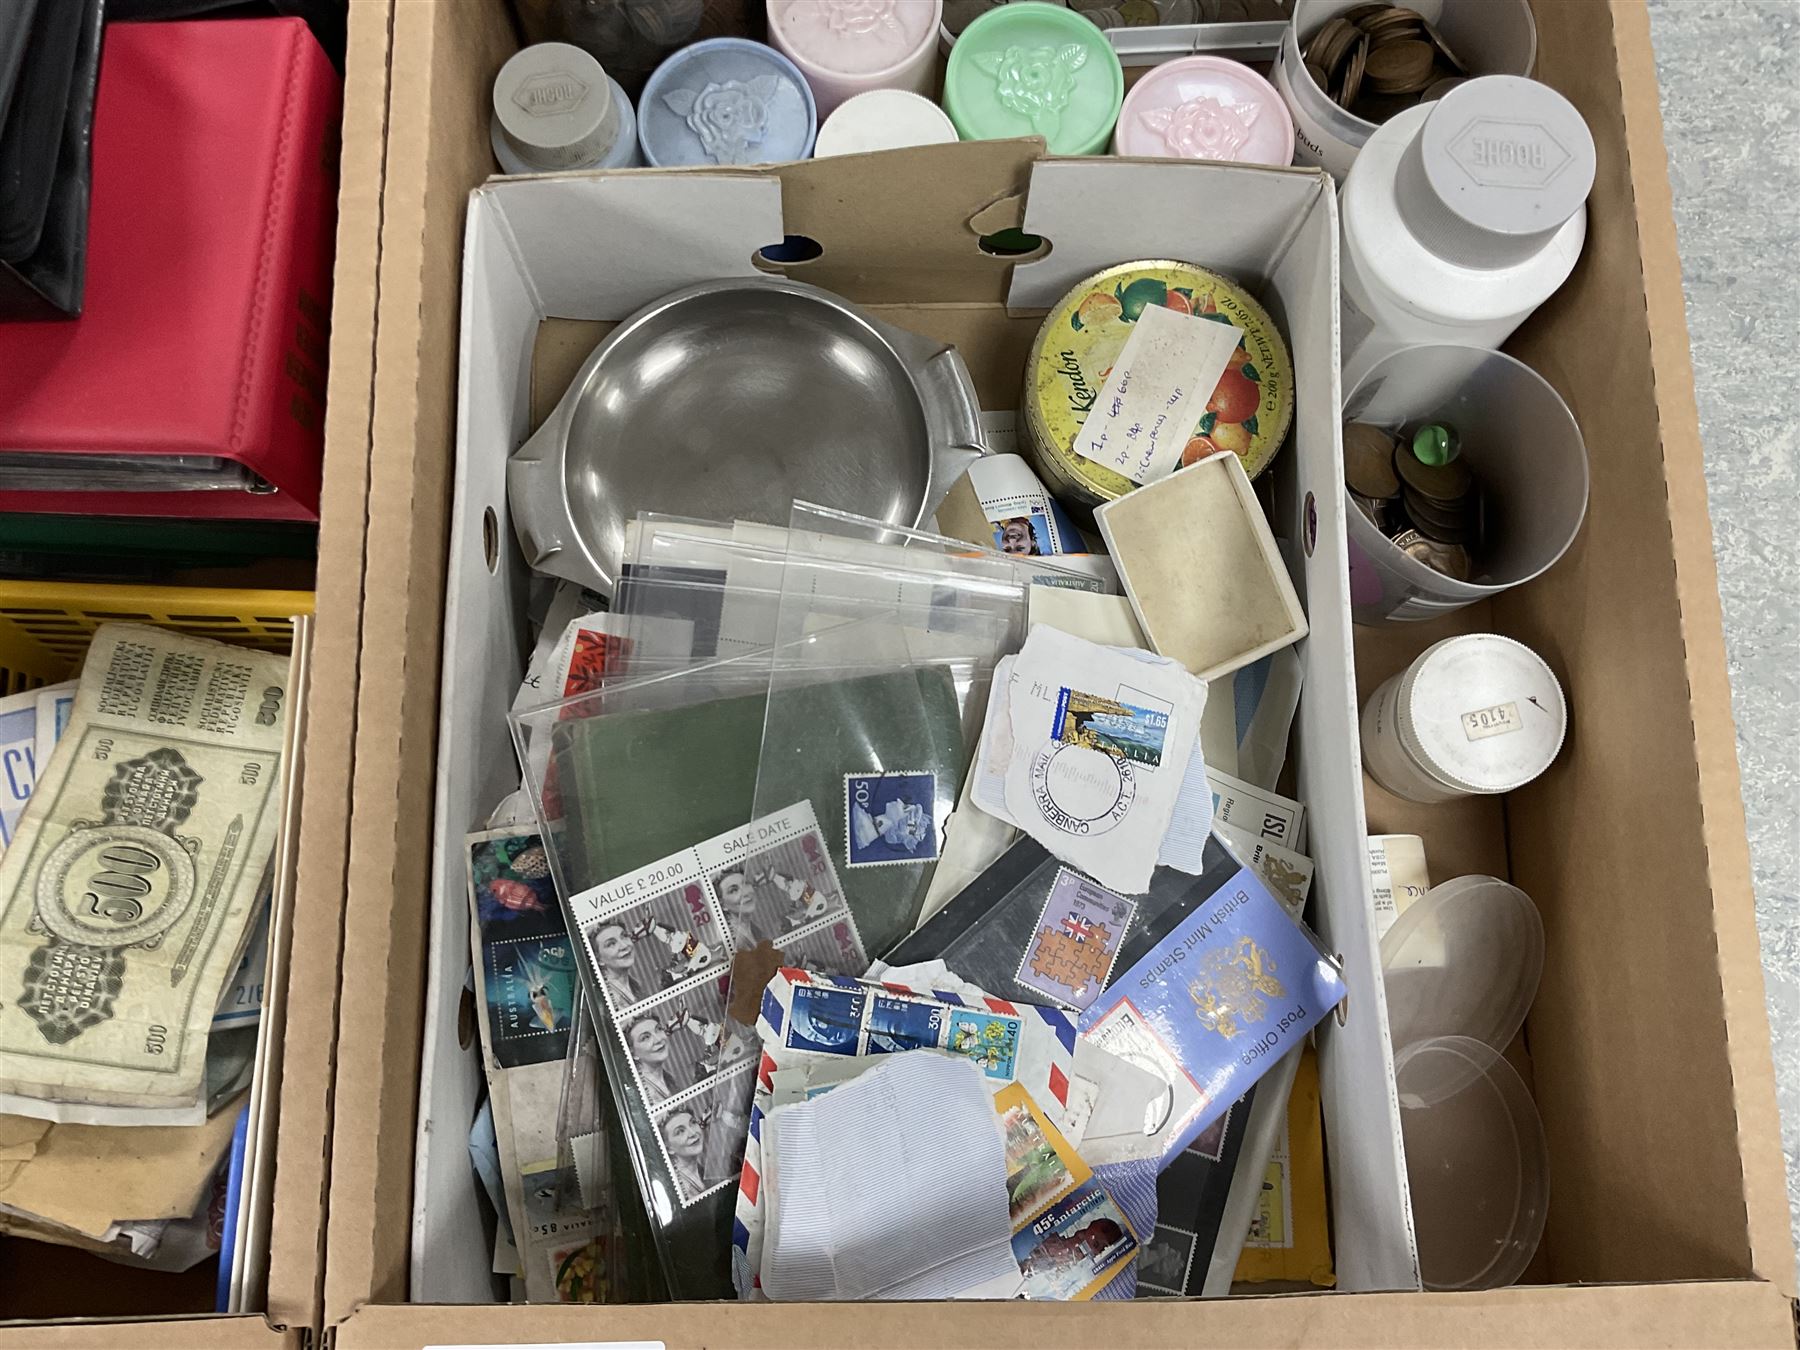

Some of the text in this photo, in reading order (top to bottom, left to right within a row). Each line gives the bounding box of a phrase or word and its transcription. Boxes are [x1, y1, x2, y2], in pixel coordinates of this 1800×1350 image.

[1297, 127, 1323, 157] buds
[1472, 137, 1546, 169] ROCHE
[1221, 296, 1237, 310] OZ
[1057, 349, 1097, 412] Kendon
[1268, 380, 1277, 399] 200
[107, 643, 137, 715] FEDERATIVNA
[117, 645, 146, 717] REPUBLIKA
[127, 647, 156, 718] JUGOSLAVIJA
[206, 664, 234, 732] FEDERATIVNA
[216, 665, 244, 734] REPUBLIKA
[225, 667, 253, 735] JUGOSLAVIJA
[255, 686, 284, 726] 500
[1469, 707, 1505, 728] 4105
[1145, 714, 1167, 728] $1.65
[92, 739, 114, 760] 500
[1034, 753, 1050, 779] MAIL
[239, 763, 261, 785] 500
[1111, 757, 1133, 821] A.C.T. 2610
[1036, 787, 1090, 834] CANBERRA
[1260, 813, 1287, 838] ISL
[723, 817, 792, 855] SALE DATE
[77, 846, 161, 922] 500
[589, 862, 684, 911] VALUE £ 20.00
[810, 860, 826, 876] 20
[693, 911, 710, 927] 20
[1139, 889, 1249, 989] British Mint Stamps
[504, 965, 519, 1029] AUSTRALIA
[928, 1008, 941, 1030] 300
[1007, 1021, 1018, 1039] 40
[1242, 1005, 1307, 1065] Post Office
[144, 1025, 168, 1055] 500
[1032, 1213, 1055, 1236] 45c
[1053, 1189, 1101, 1227] antarctic
